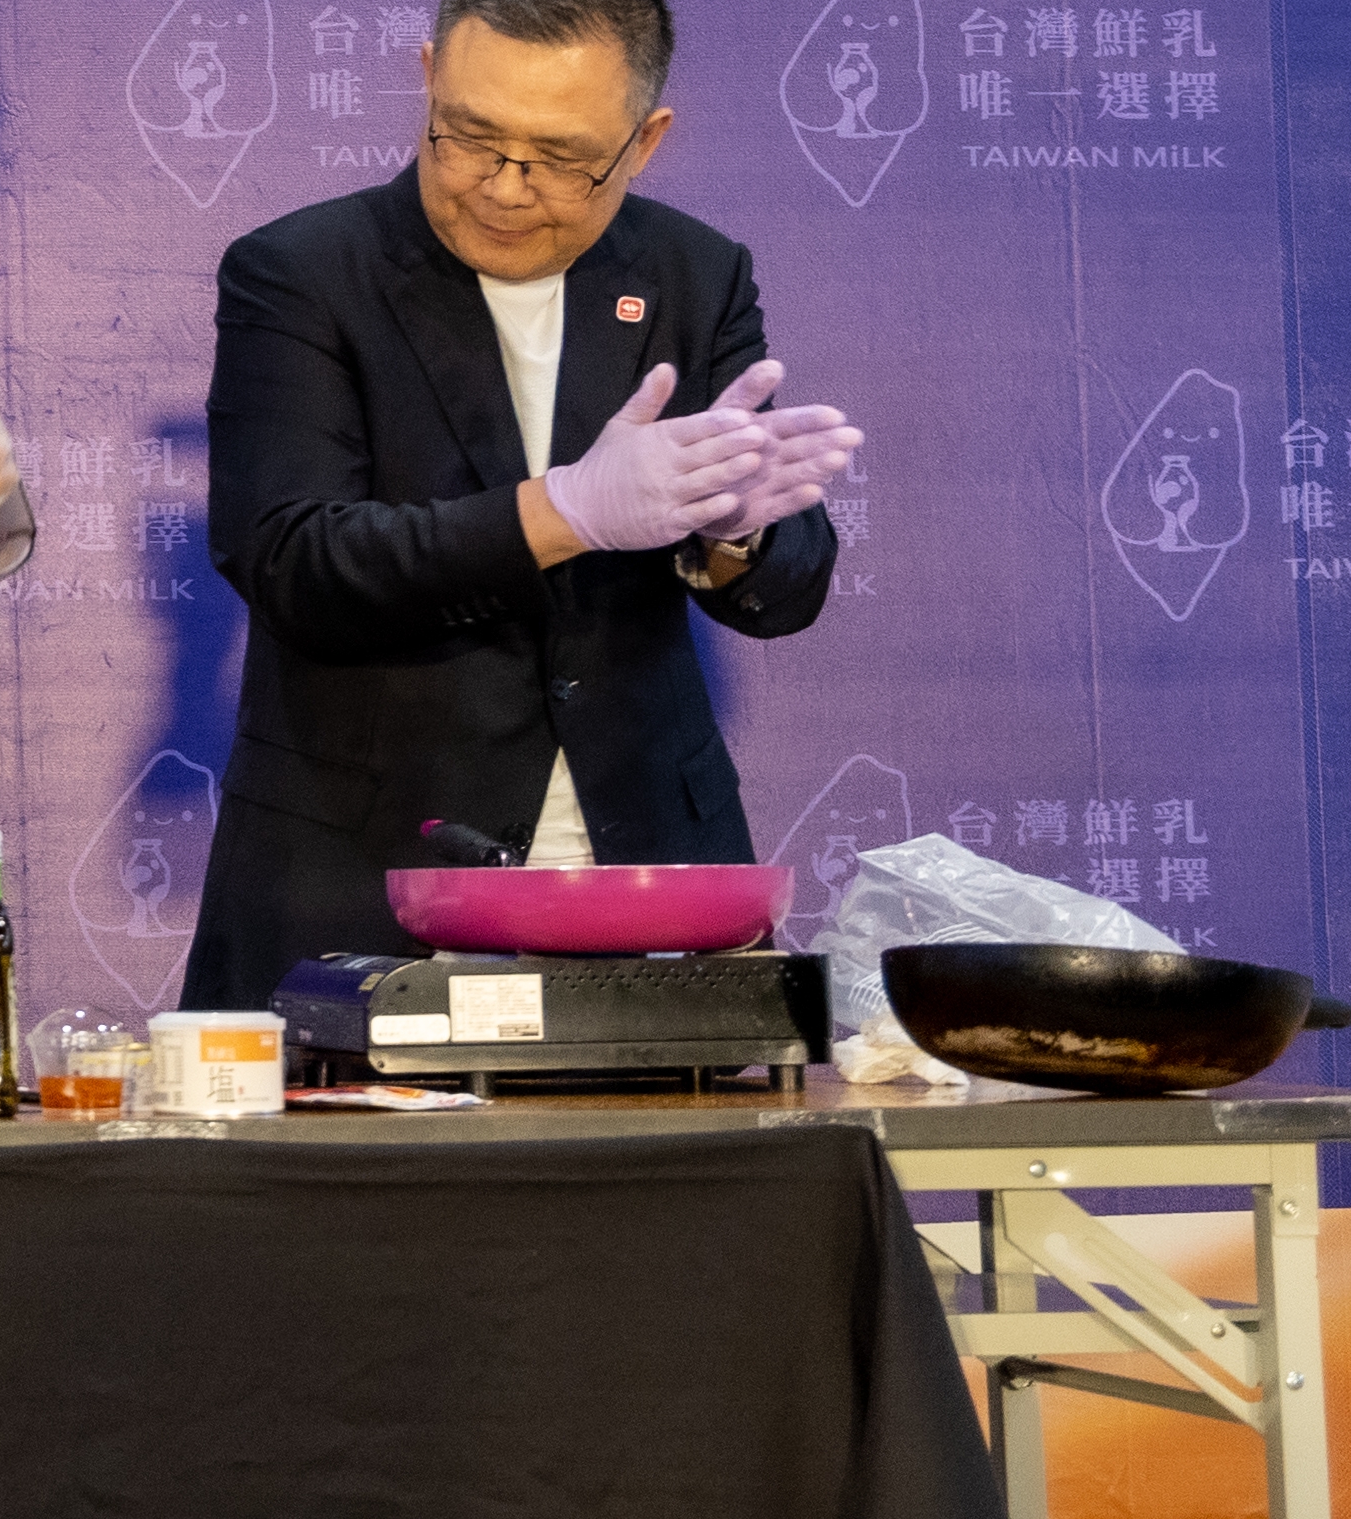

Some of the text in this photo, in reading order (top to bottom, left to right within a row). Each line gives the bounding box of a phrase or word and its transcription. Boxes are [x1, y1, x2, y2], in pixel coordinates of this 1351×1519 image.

[958, 7, 1219, 59] 台灣鮮乳
[958, 69, 1220, 121] 唯一選擇
[960, 143, 1228, 169] TAIWAN MiLK
[947, 798, 1209, 847] 台灣鮮乳
